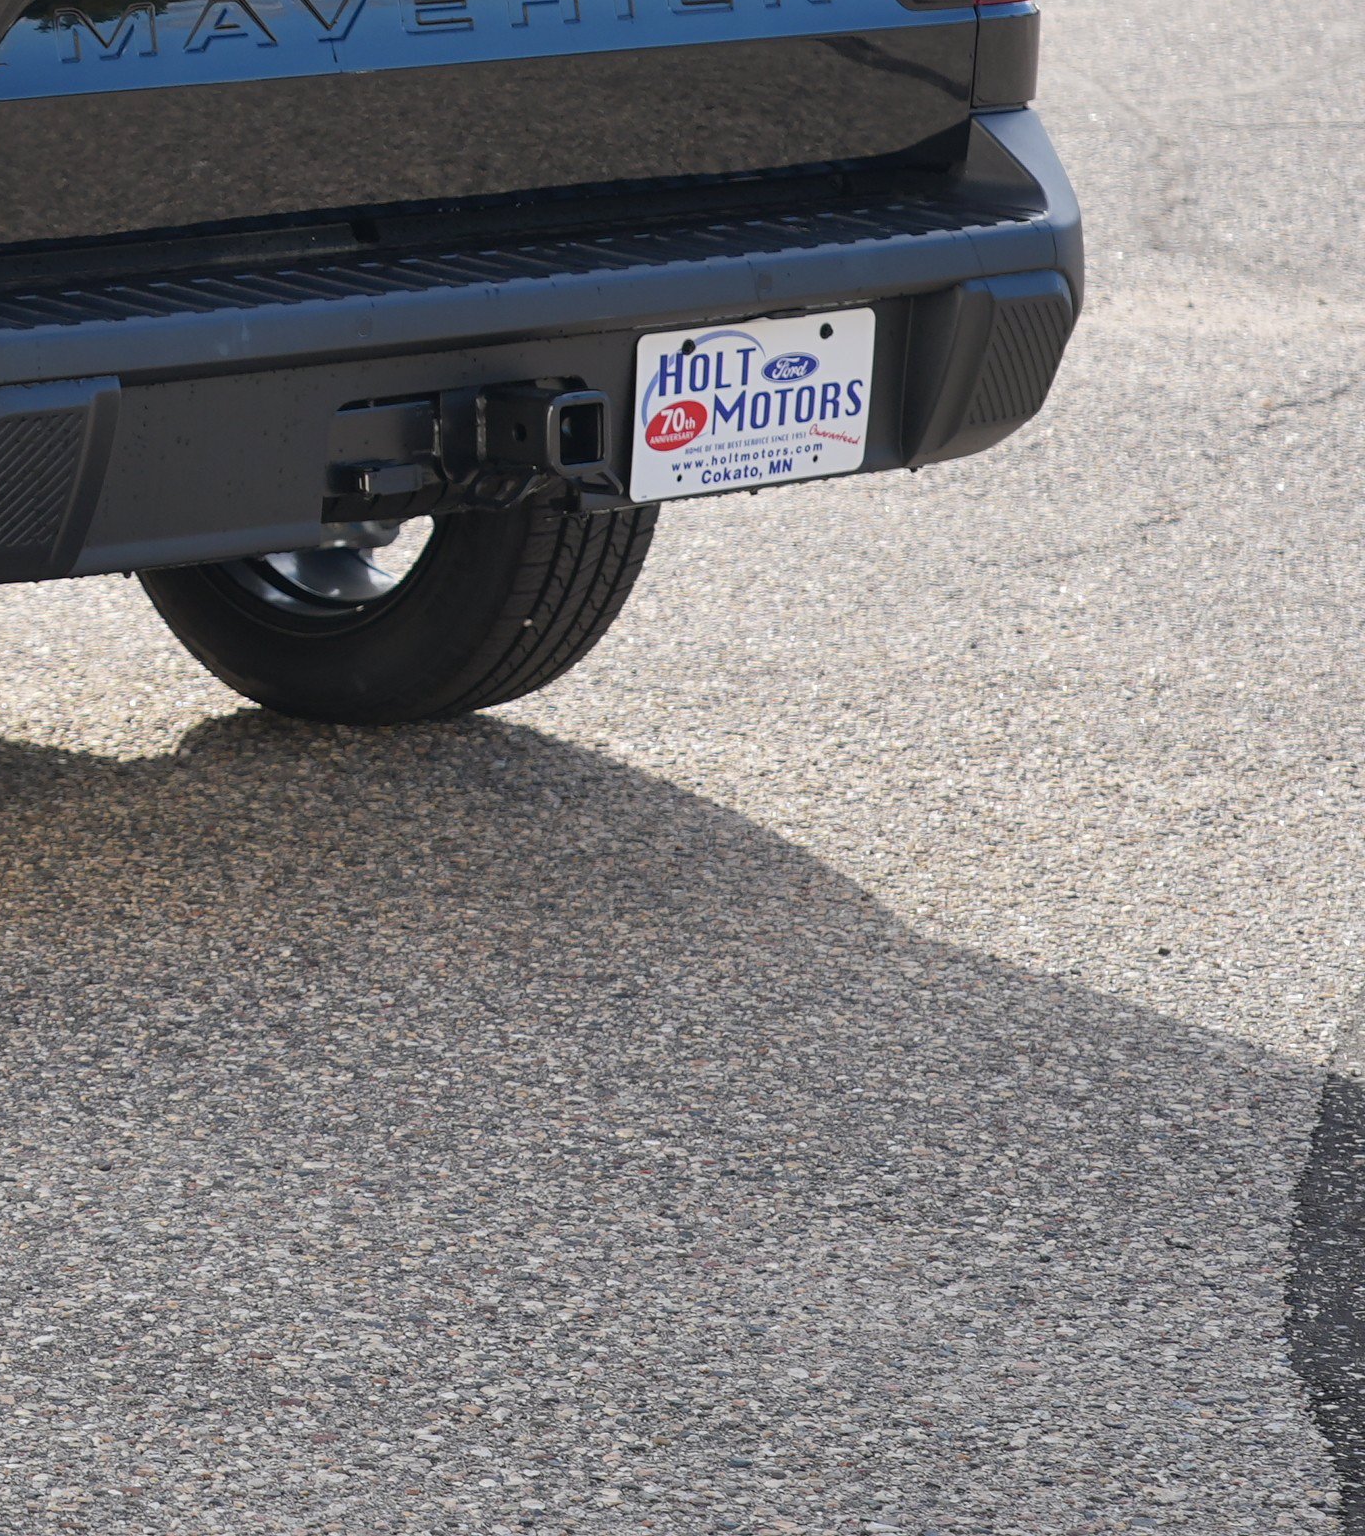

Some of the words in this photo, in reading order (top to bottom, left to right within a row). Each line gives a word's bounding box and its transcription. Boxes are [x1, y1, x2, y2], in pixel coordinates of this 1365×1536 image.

[658, 347, 756, 397] HOLT
[771, 357, 808, 379] Ford
[660, 406, 696, 435] 70th
[712, 379, 864, 435] MOTORS
[649, 431, 695, 445] ANNIVERSARY
[685, 445, 702, 455] HOME
[704, 444, 712, 452] OF
[714, 442, 725, 451] THE
[727, 440, 742, 449] BEST
[744, 437, 769, 447] SERVICE
[771, 433, 789, 443] SINCE
[809, 423, 861, 445] Guaranteed
[672, 441, 823, 472] www.holtmotors.com
[701, 465, 763, 484] Cokato,
[769, 458, 793, 475] MN
